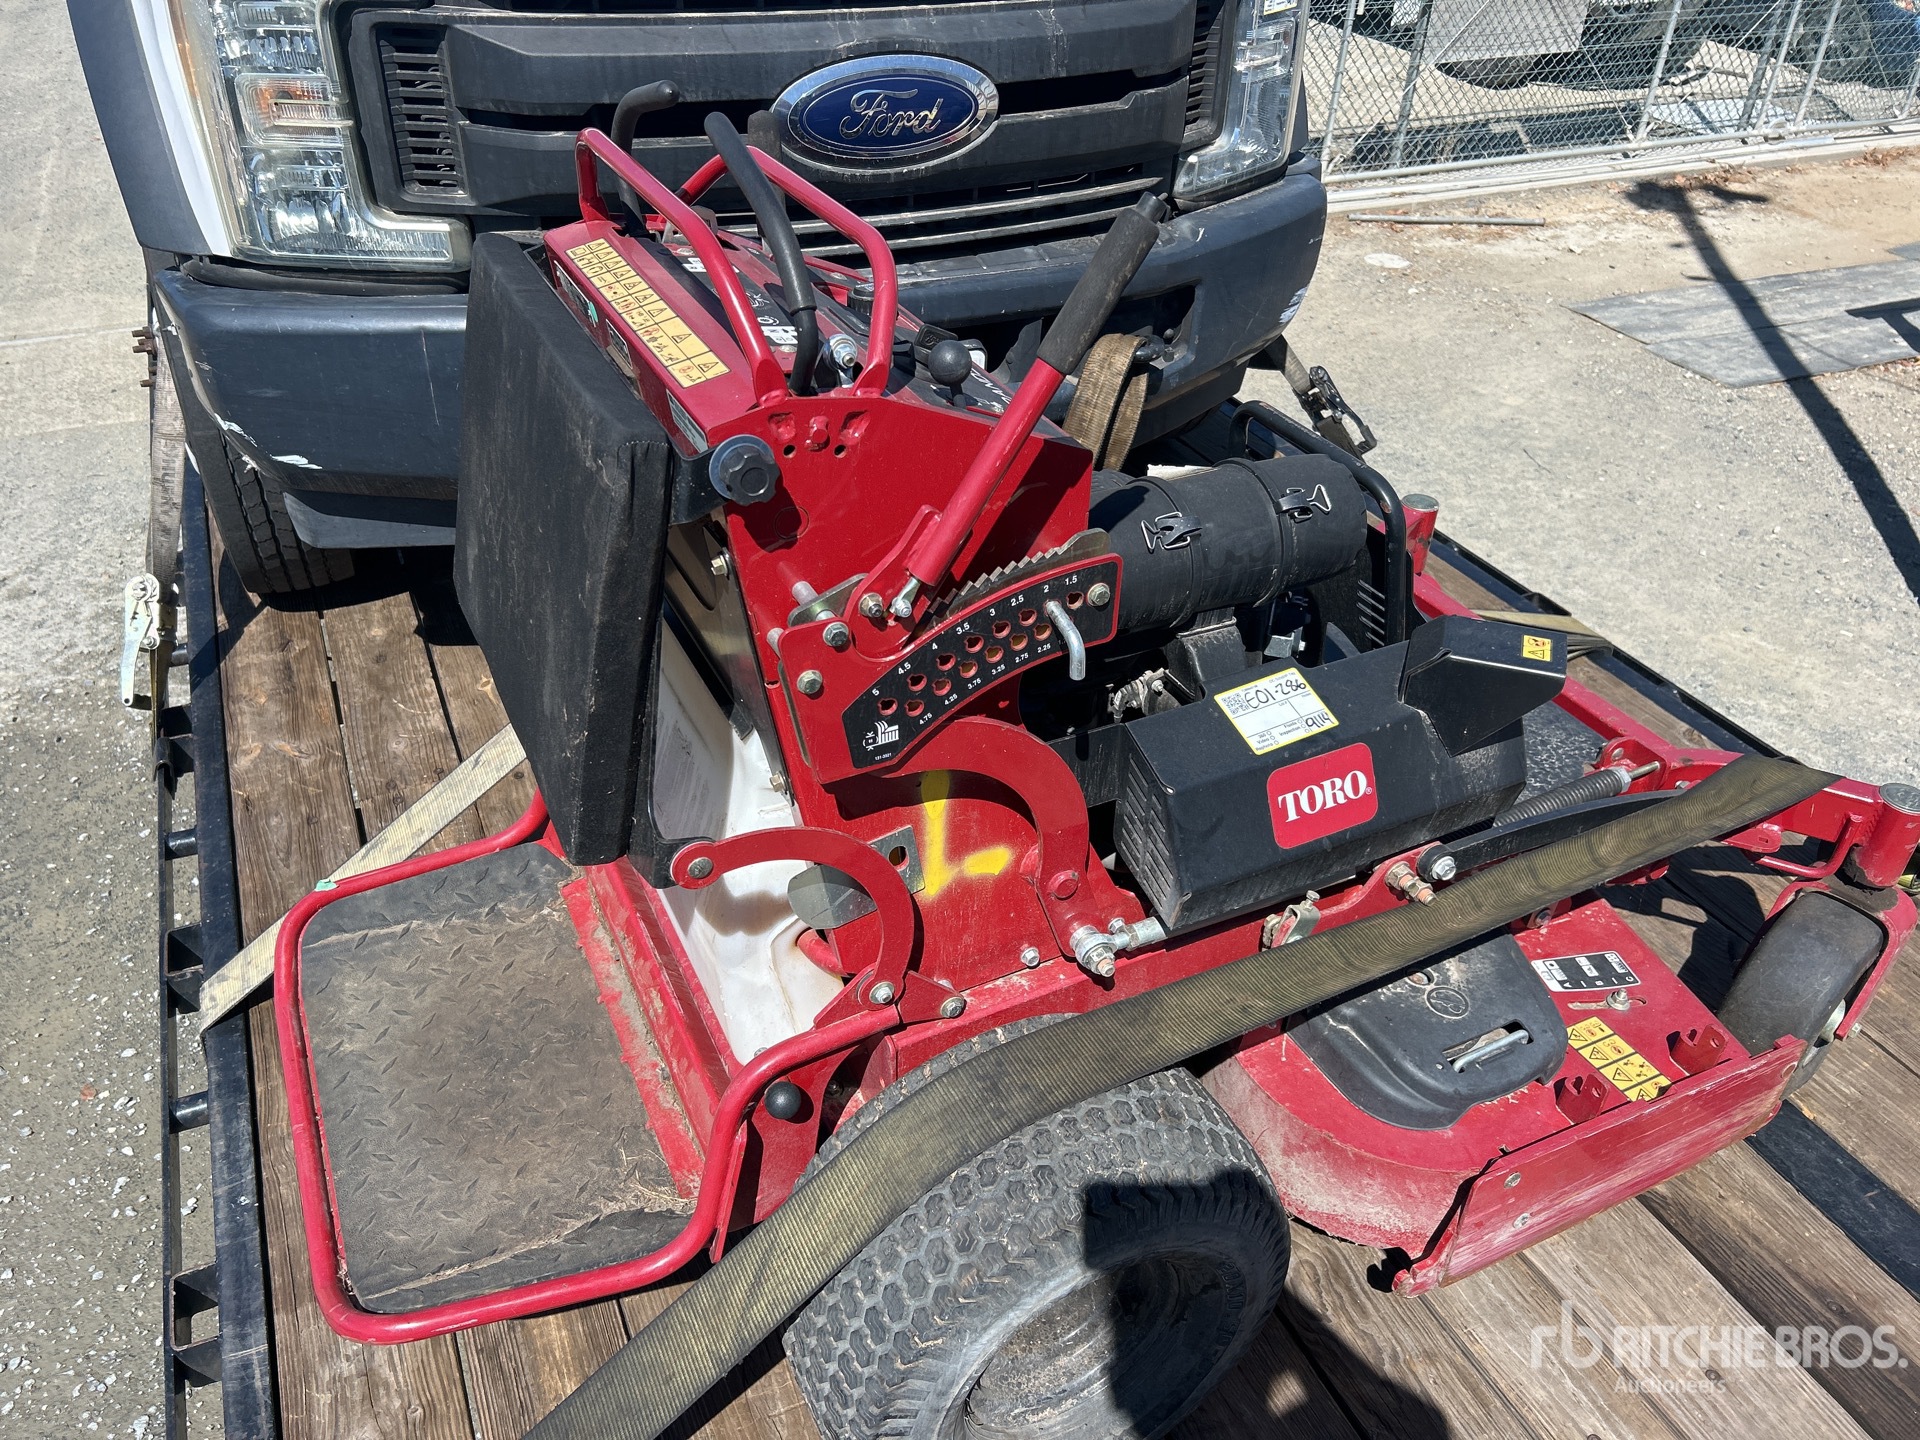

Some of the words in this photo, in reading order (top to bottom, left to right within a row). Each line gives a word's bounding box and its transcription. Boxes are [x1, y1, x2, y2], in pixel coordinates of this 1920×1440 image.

[839, 88, 944, 140] Ford
[1064, 575, 1078, 586] 1.5
[1043, 584, 1050, 593] 2
[1010, 594, 1025, 607] 2.5
[989, 608, 996, 617] 3
[955, 622, 970, 635] 3.5
[931, 642, 938, 651] 4
[1037, 642, 1051, 654] 2.25
[1014, 652, 1029, 664] 2.75
[897, 661, 912, 676] 4.5
[991, 663, 1006, 676] 3.25
[967, 677, 982, 691] 3.75
[871, 688, 880, 697] 5
[944, 693, 958, 706] 4.25
[918, 711, 933, 726] 4.75
[1277, 770, 1368, 823] TORO
